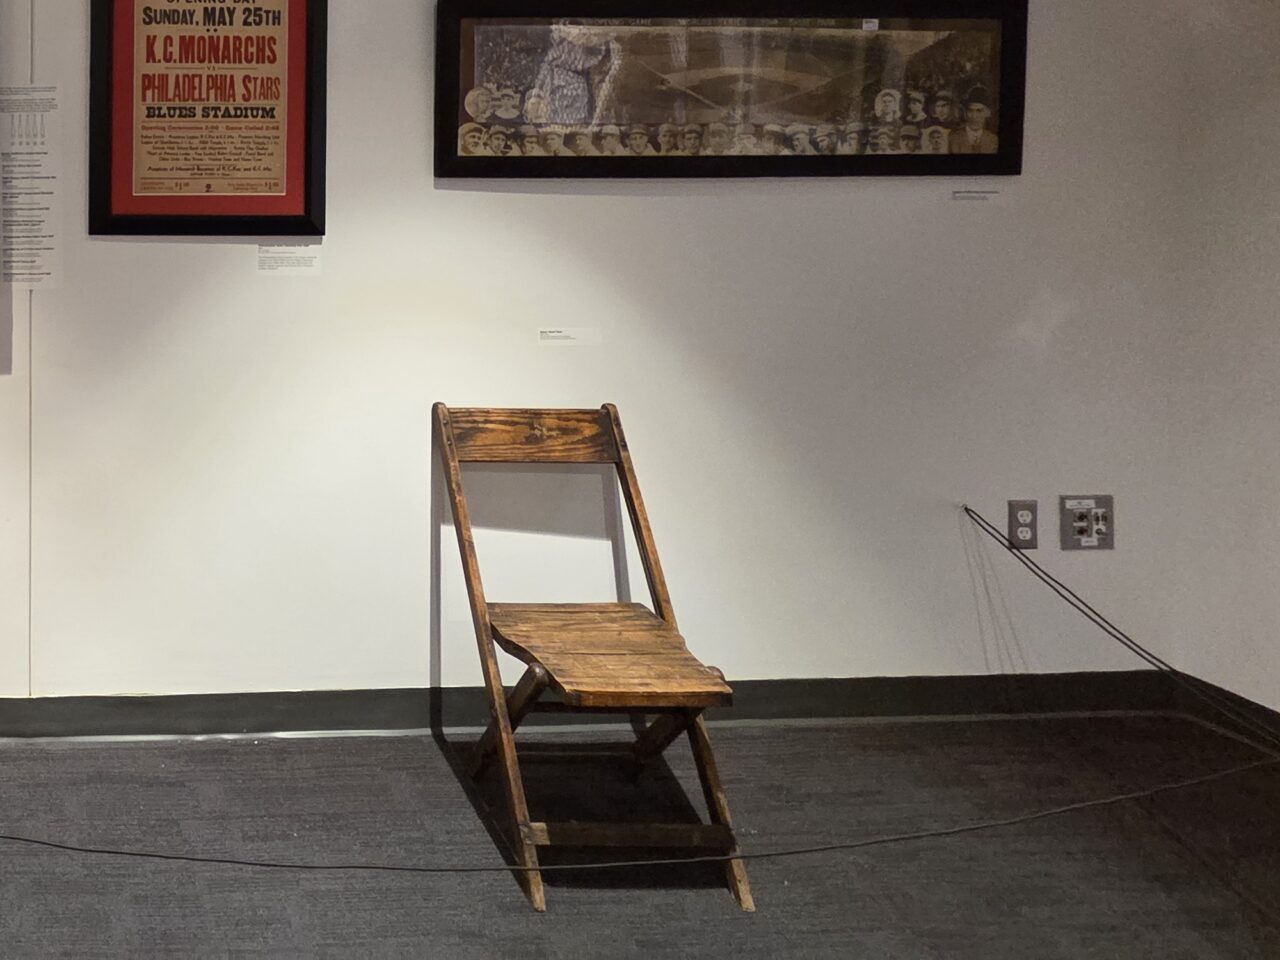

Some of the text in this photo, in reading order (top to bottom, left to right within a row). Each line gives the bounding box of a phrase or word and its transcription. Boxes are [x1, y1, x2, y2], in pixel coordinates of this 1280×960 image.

[203, 6, 236, 27] MAY
[242, 7, 281, 27] 25TH
[141, 73, 281, 103] PHILADELPHIA STARS
[145, 106, 276, 119] BLUES STADIUM
